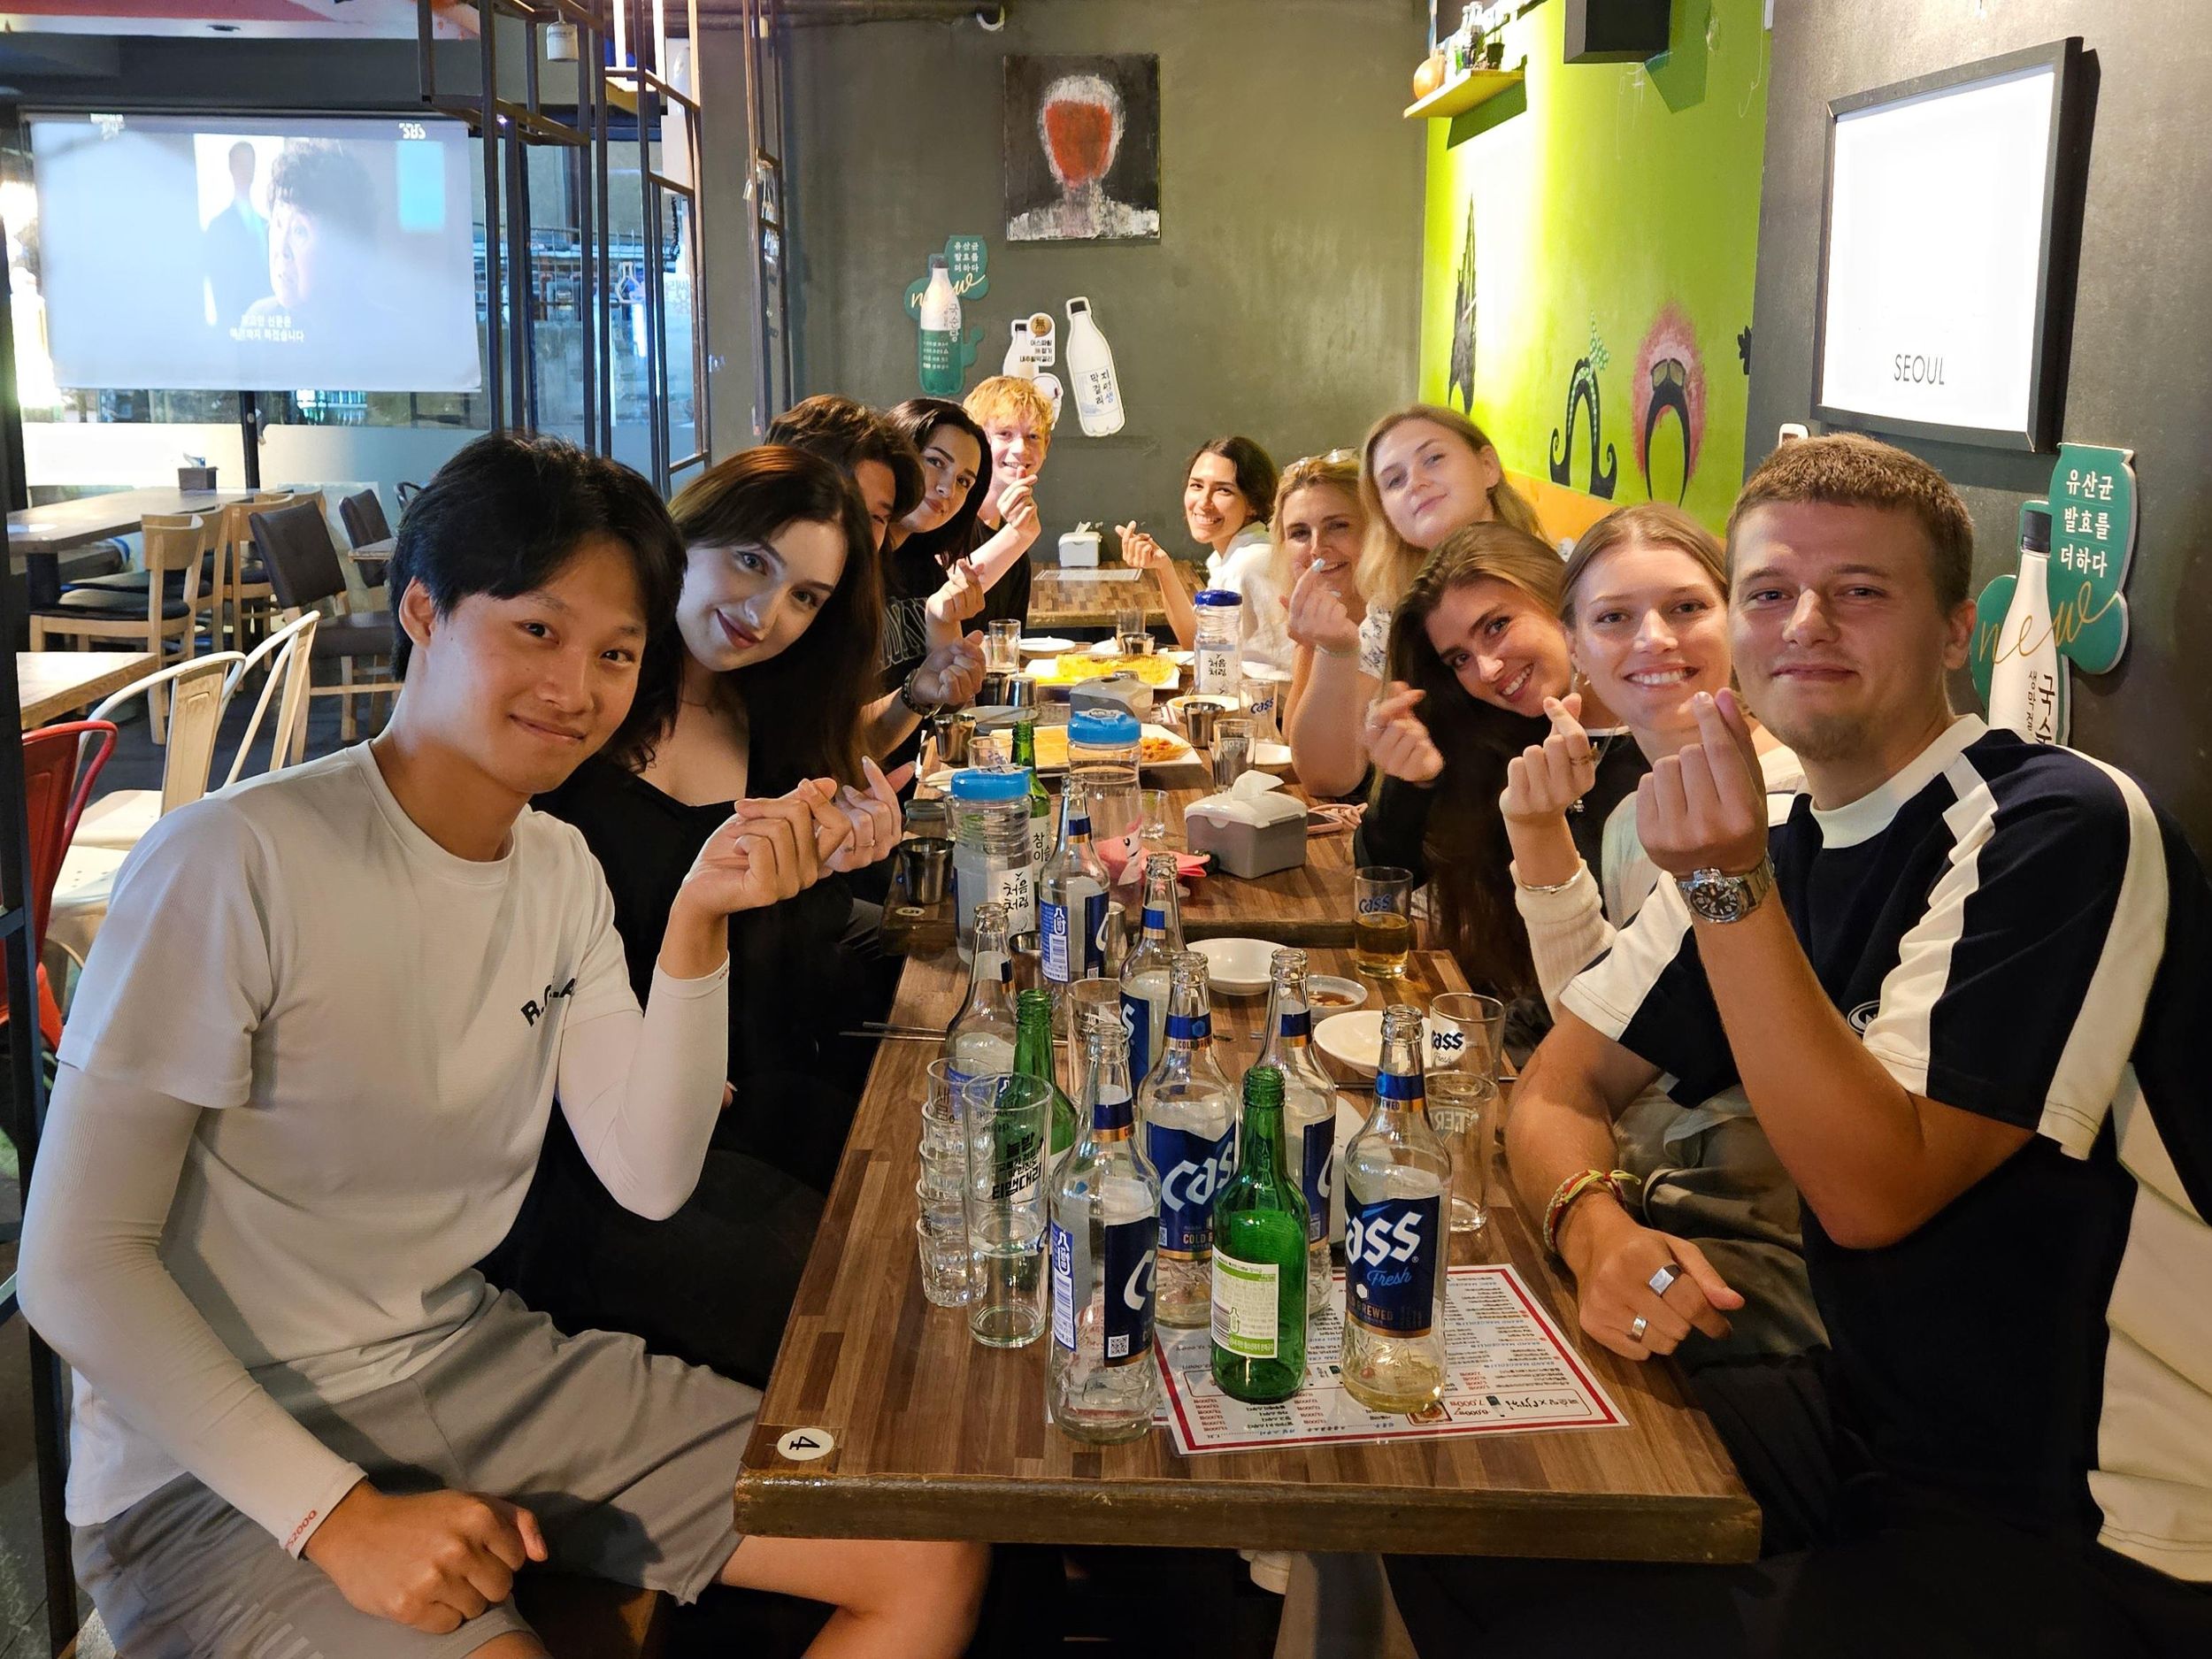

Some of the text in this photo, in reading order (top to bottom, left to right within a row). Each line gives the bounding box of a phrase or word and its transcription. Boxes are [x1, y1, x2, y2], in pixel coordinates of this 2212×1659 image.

[1893, 353, 1945, 385] SEOUL
[2066, 469, 2114, 500] 유산균
[2063, 506, 2111, 540] 발효를
[2060, 543, 2108, 578] 더하다
[2038, 673, 2055, 745] 국순
[1003, 879, 1029, 896] 처음
[1004, 895, 1030, 912] 처럼
[1345, 1207, 1424, 1267] ass
[1366, 1267, 1412, 1286] Fresh
[788, 1435, 820, 1451] 4
